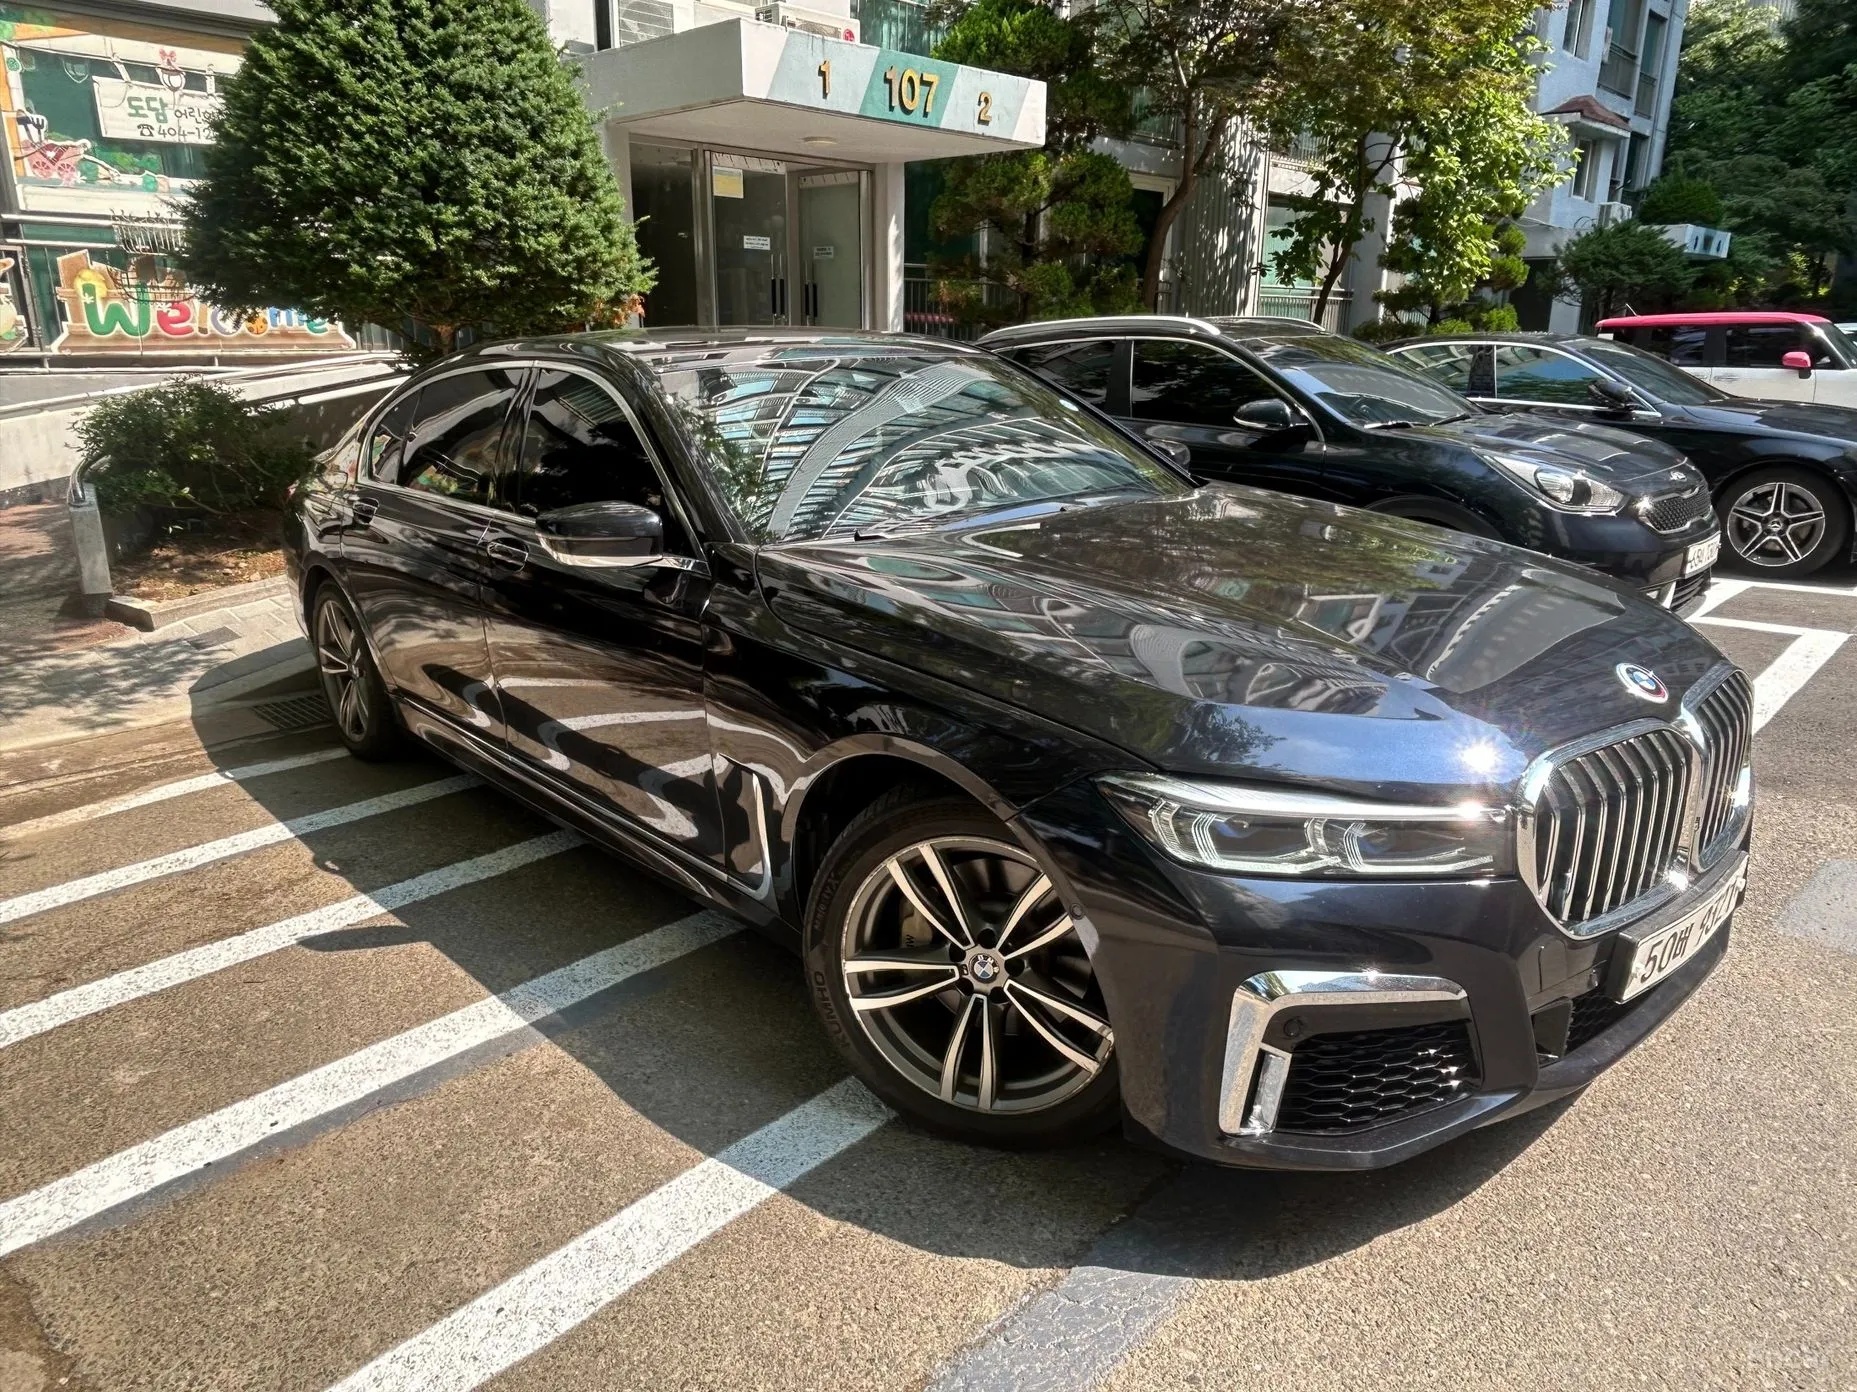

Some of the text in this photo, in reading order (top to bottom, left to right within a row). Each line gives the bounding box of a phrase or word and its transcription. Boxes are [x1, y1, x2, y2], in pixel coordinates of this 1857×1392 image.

[127, 96, 168, 123] 도담
[819, 58, 993, 123] 1 107 2
[158, 125, 215, 142] 404-12
[1640, 922, 1695, 983] 50배
